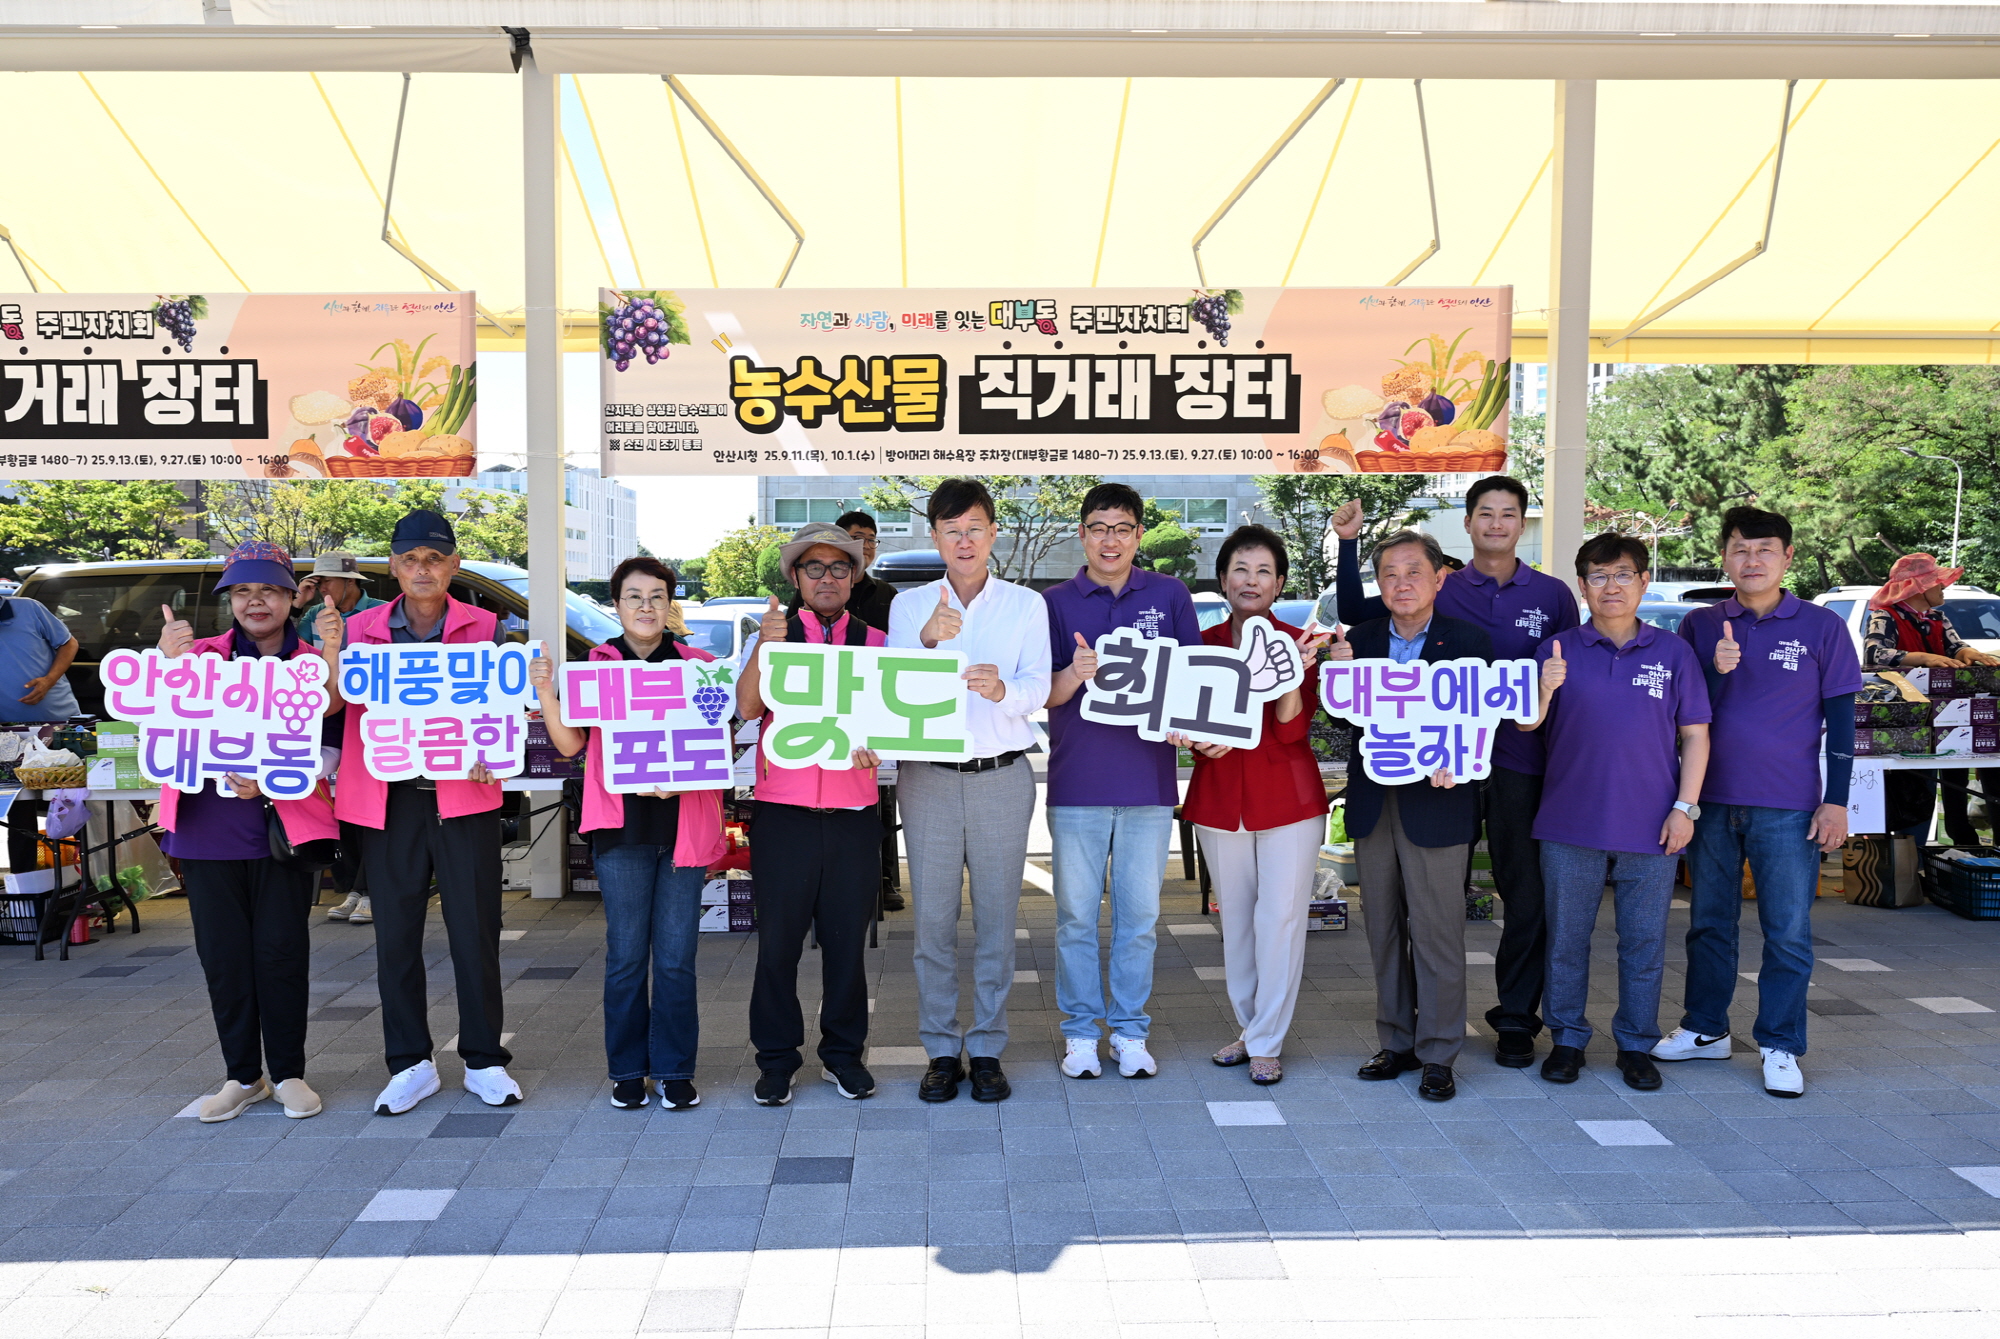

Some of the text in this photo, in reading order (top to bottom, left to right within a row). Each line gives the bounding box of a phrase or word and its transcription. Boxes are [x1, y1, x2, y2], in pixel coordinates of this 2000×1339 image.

[433, 302, 458, 313] 안산
[800, 299, 1189, 335] 자연과 사람, 미래를 잇는 대부동 주민자치회
[1469, 297, 1494, 308] 안산
[36, 310, 155, 339] 주민자치회
[141, 363, 255, 425] 장터
[604, 404, 728, 416] 산지직송 싱싱한 농수산물이
[730, 355, 1288, 433] 농수산물 직거래 장터
[605, 421, 699, 434] 여러분을 찾아갑니다.
[624, 439, 644, 451] 소진
[647, 439, 657, 451] 시
[660, 439, 680, 451] 조기
[683, 439, 702, 451] 종료
[41, 454, 88, 466] 1480-7)
[91, 454, 157, 467] 25.9.13.(토),
[160, 454, 207, 466] 9.27.(토)
[210, 454, 242, 465] 10:00
[257, 454, 290, 466] 16:00
[713, 450, 758, 463] 안산시청
[831, 449, 875, 462] 10.1.(수)
[885, 449, 930, 463] 방아머리
[933, 449, 976, 463] 해수욕장
[979, 448, 1069, 463] 주차장(대부황금로
[1071, 449, 1119, 461] 1480-7)
[1122, 449, 1189, 462] 25.9.13.(토),
[1191, 449, 1237, 461] 9.27.(토)
[1241, 449, 1273, 460] 10:00
[1288, 449, 1320, 461] 16:00
[1768, 652, 1799, 662] 대부포도
[1785, 646, 1800, 654] 안산
[107, 655, 275, 721] 안산시
[342, 649, 543, 706] 해풍맞이
[1088, 636, 1253, 740] 최고
[1325, 665, 1531, 719] 대부에서
[1632, 677, 1665, 690] 대부포도
[1648, 670, 1665, 680] 안산
[566, 666, 687, 721] 대부
[768, 650, 965, 761] 맛도
[145, 727, 316, 794] 대부동
[366, 713, 520, 773] 달콤한
[612, 727, 729, 785] 포도
[1365, 723, 1488, 778] 놀자!
